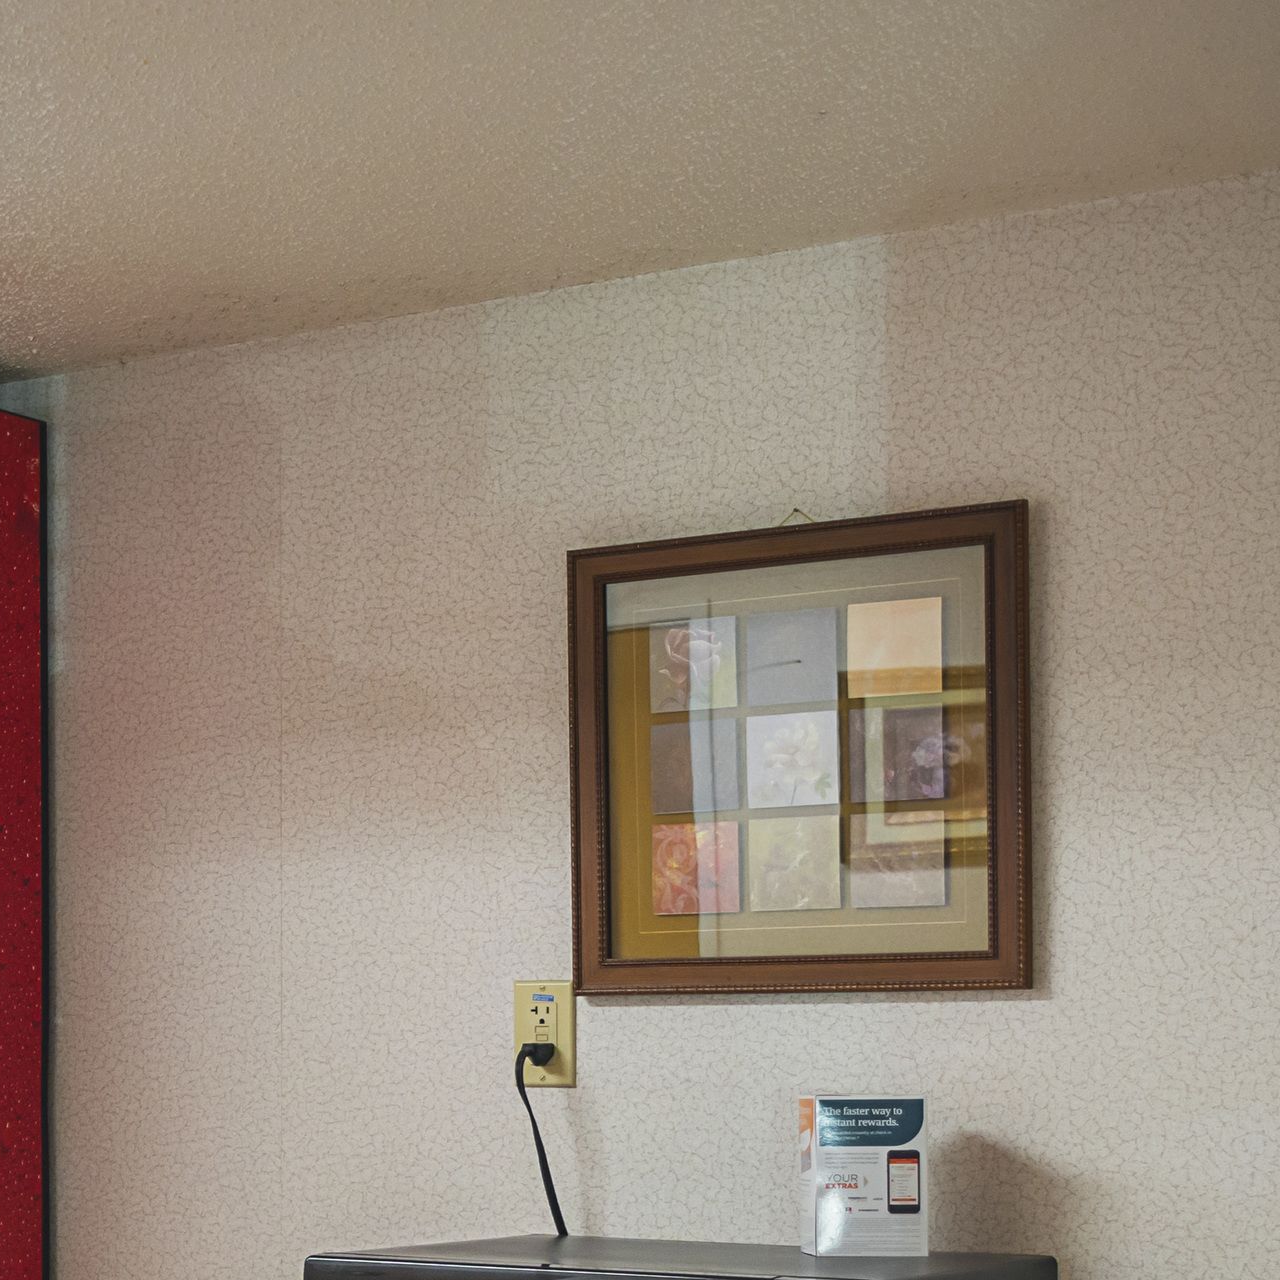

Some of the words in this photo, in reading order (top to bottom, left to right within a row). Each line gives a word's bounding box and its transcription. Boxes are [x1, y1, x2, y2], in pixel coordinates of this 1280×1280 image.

[824, 1106, 841, 1116] The
[843, 1106, 871, 1116] faster
[871, 1108, 891, 1117] way
[893, 1107, 903, 1116] to
[858, 1118, 899, 1127] rewards.
[828, 1173, 858, 1183] YOUR
